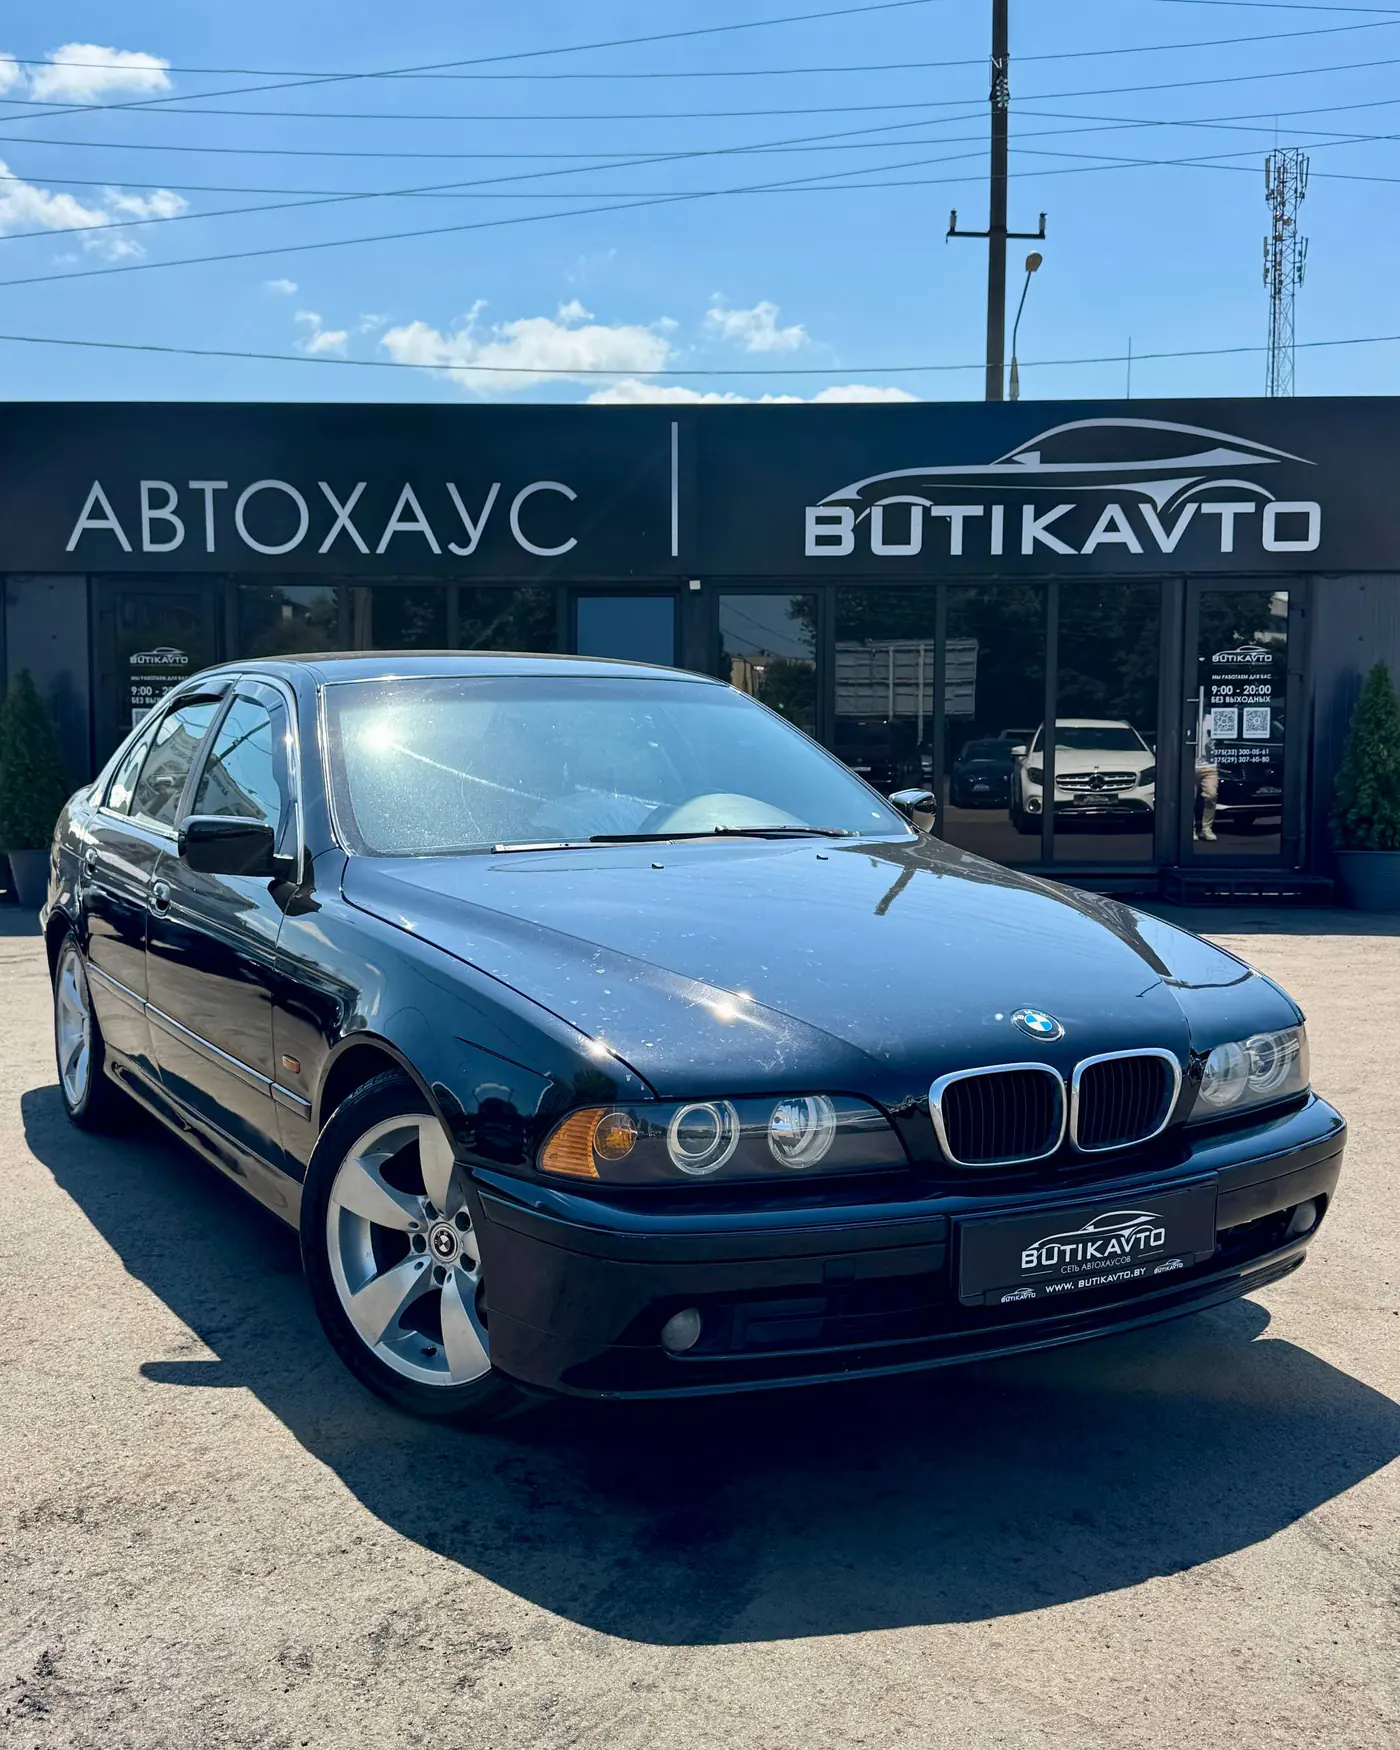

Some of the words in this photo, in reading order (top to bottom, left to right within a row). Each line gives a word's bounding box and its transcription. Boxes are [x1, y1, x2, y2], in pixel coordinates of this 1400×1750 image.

[65, 479, 578, 557] АВТОХАУС
[804, 501, 1322, 557] BUTIKAVTO
[130, 656, 189, 664] BUTIKAVTO
[1211, 653, 1273, 662] BUTIKAVTO
[131, 686, 153, 696] 9:00
[1211, 685, 1233, 695] 9:00
[1243, 685, 1271, 695] 20:00
[1021, 1227, 1165, 1269] BUTIKAVTO
[1060, 1264, 1080, 1274] СЕТЬ
[1081, 1255, 1132, 1272] АВТОХАУСОВ
[1045, 1282, 1074, 1293] WWW.
[1078, 1267, 1147, 1288] BUTIKAVTO.BY
[1001, 1292, 1036, 1303] BUTIKAVTO
